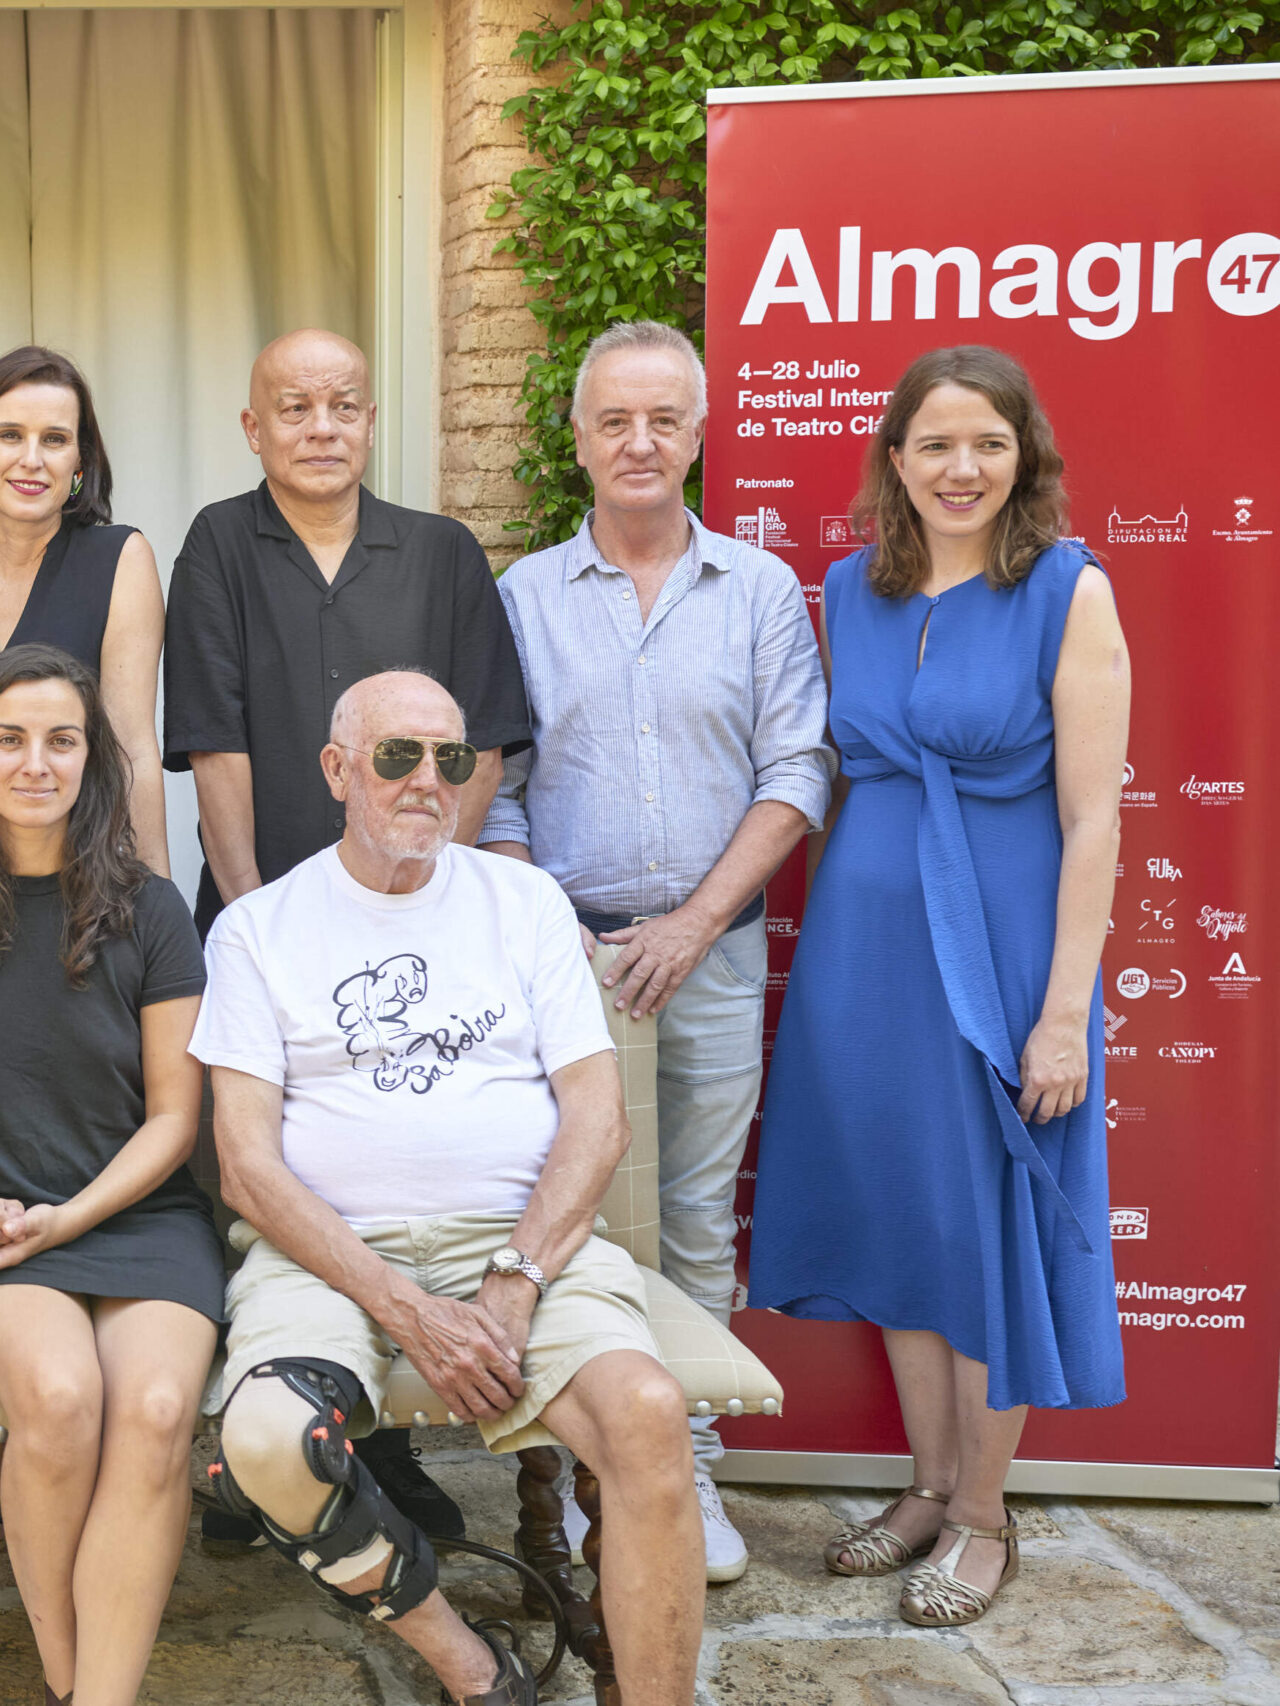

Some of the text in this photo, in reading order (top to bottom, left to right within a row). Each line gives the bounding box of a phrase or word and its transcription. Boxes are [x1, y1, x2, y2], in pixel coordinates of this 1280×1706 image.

[1219, 254, 1279, 295] 47
[805, 359, 861, 379] Julio
[737, 388, 823, 409] Festival
[736, 418, 766, 438] de
[771, 417, 844, 437] Teatro
[735, 477, 794, 488] Patronato
[765, 507, 779, 515] AL
[765, 522, 787, 531] GRO
[1107, 533, 1188, 543] CIUDAD REAL
[1122, 973, 1145, 985] UGT
[1158, 1047, 1218, 1058] CANOPY
[1115, 1281, 1247, 1305] #Almagro47
